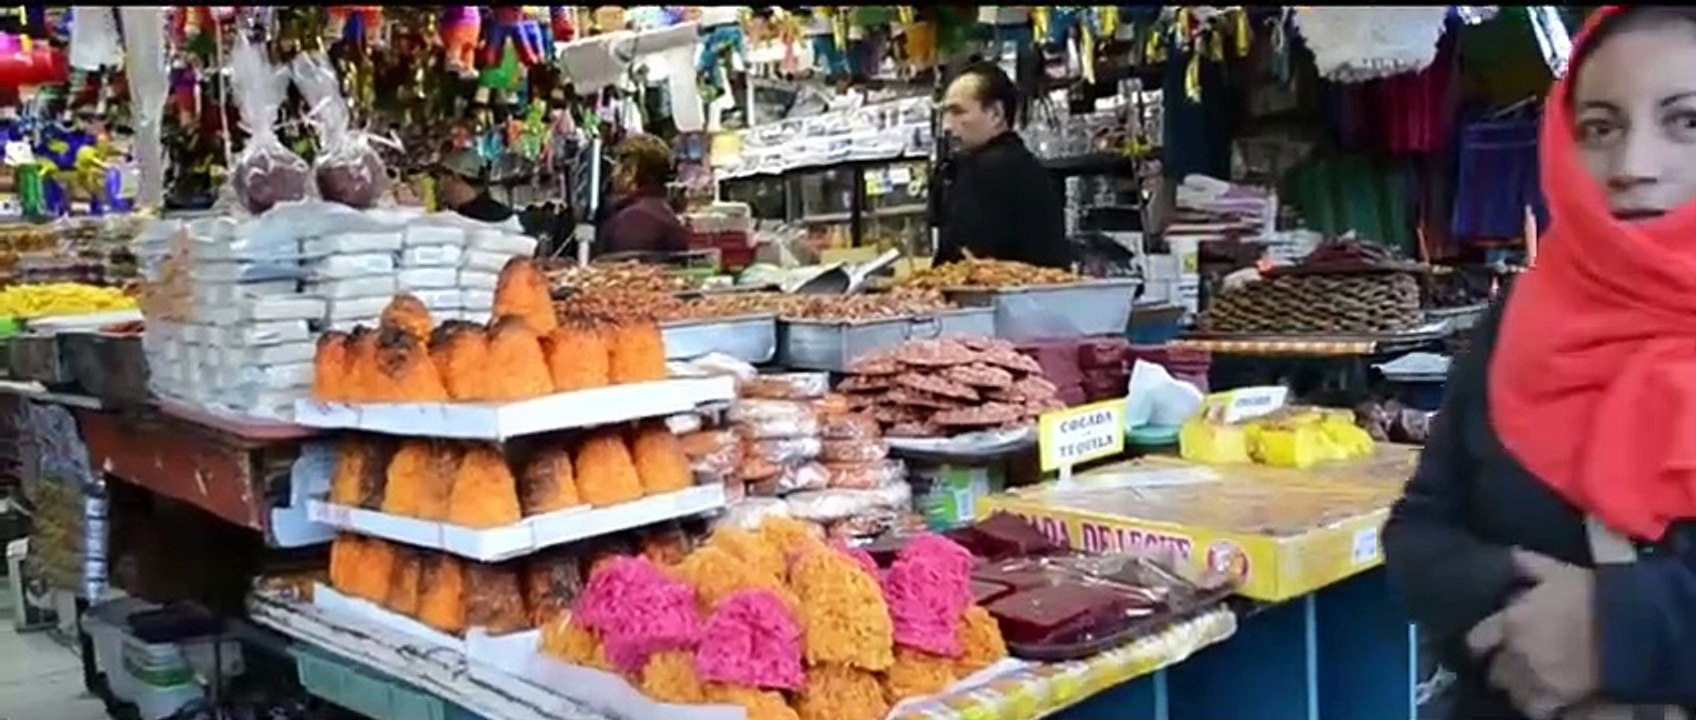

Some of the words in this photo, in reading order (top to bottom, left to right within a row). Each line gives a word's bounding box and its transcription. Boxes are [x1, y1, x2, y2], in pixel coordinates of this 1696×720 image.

[1060, 411, 1112, 433] COCADA
[1059, 434, 1114, 457] TEQUILA
[1082, 522, 1111, 552] DE
